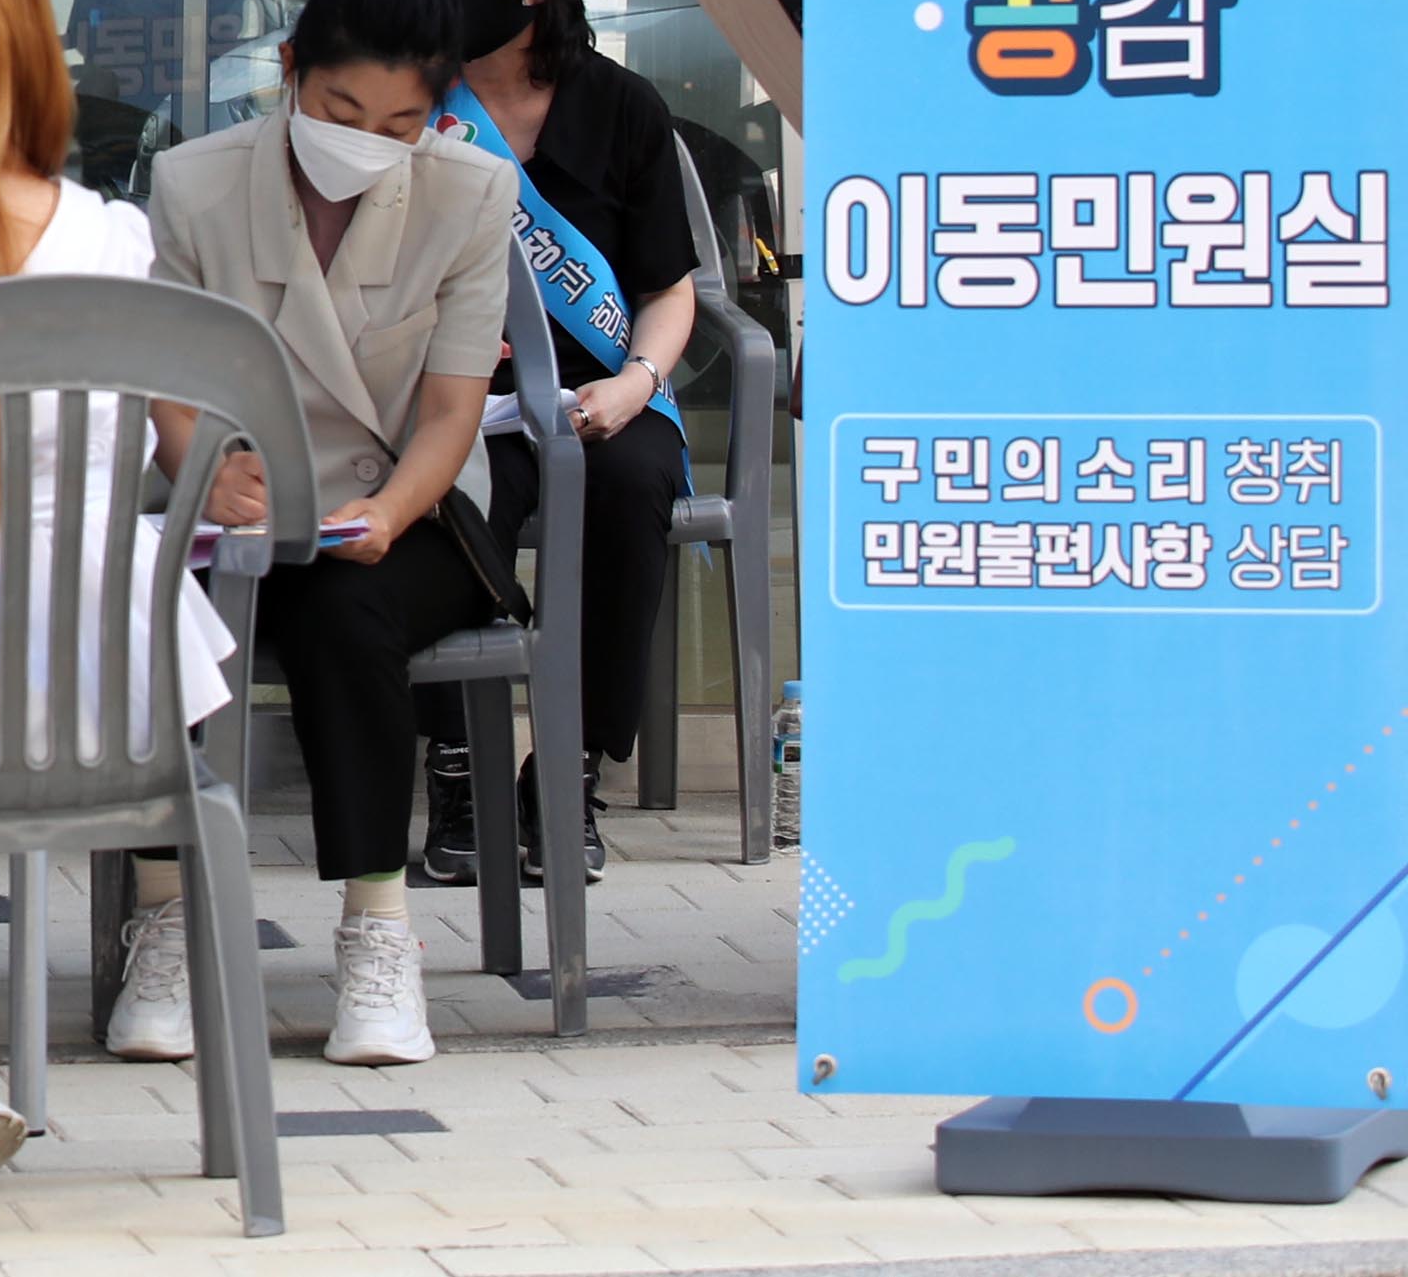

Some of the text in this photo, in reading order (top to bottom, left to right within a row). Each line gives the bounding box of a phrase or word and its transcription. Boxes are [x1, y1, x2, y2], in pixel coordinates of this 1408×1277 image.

[824, 170, 1390, 308] 이동민원실
[862, 436, 1343, 505] 구민의 소리 청취
[862, 520, 1349, 590] 민원불편사항 상담
